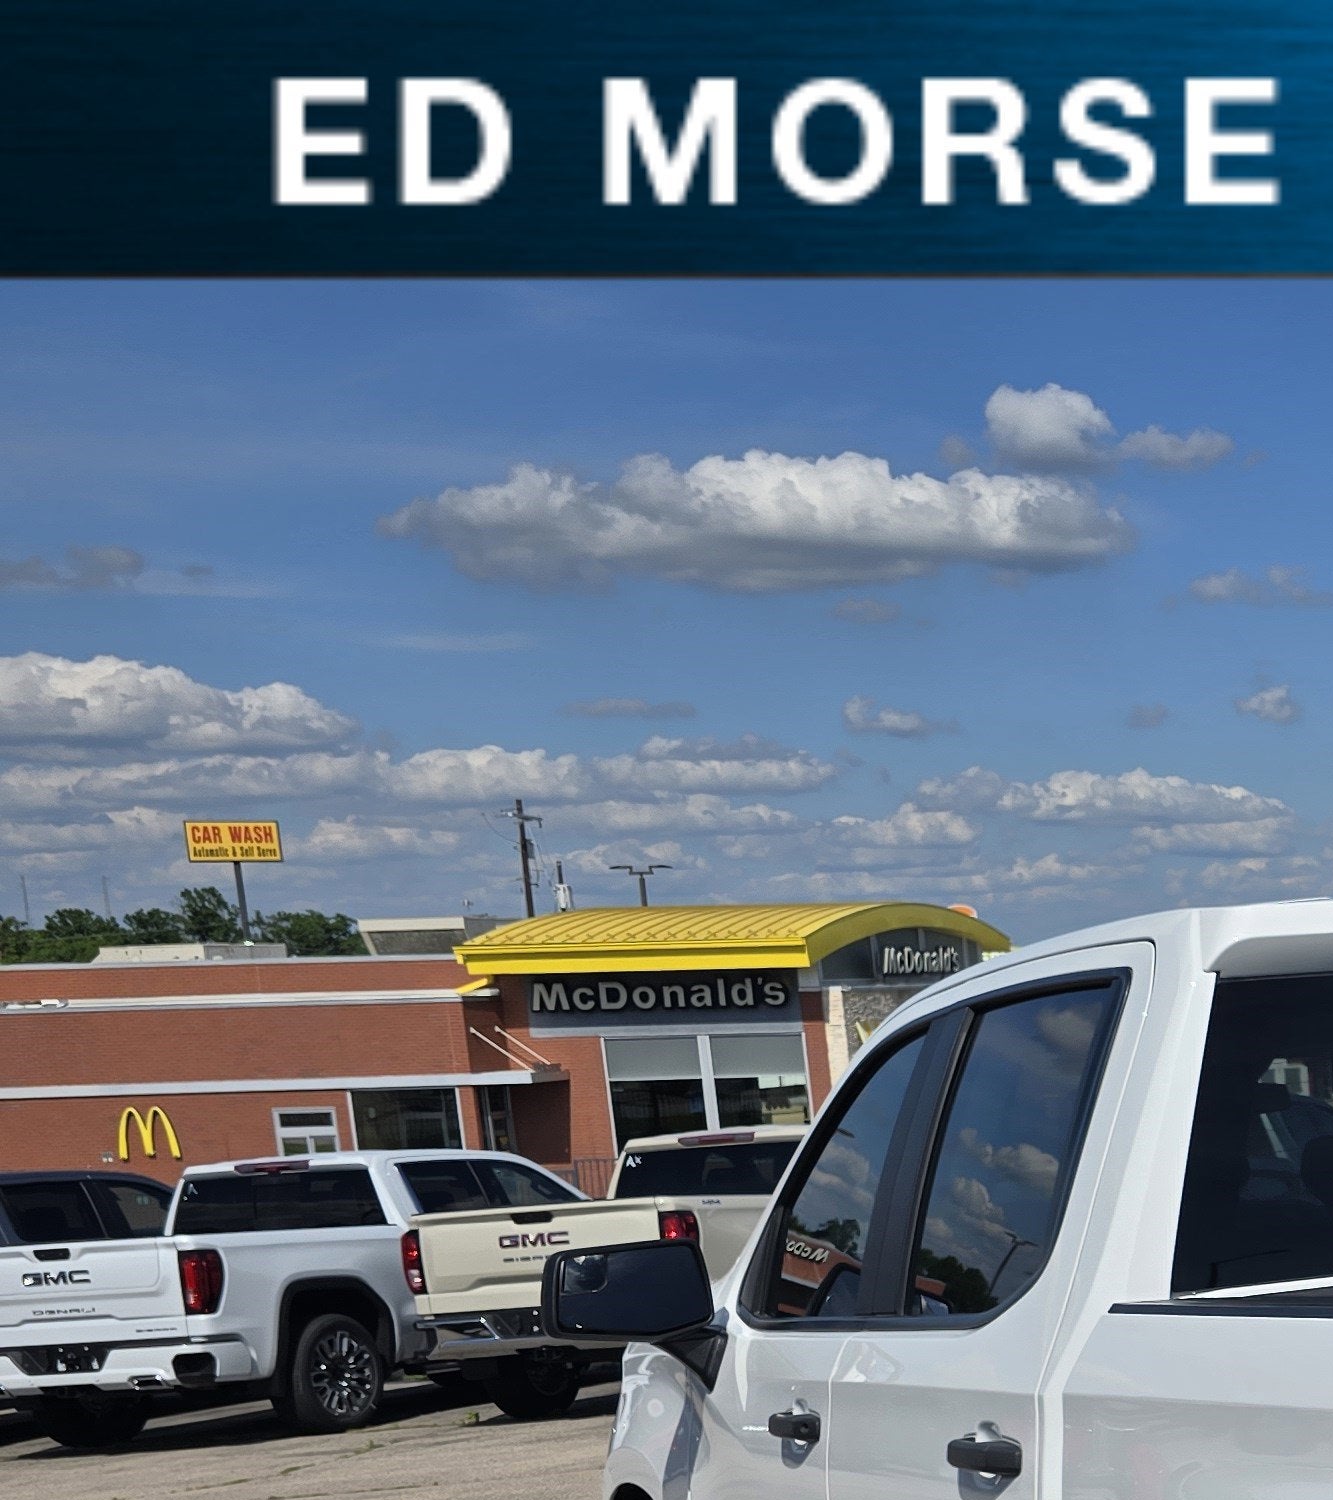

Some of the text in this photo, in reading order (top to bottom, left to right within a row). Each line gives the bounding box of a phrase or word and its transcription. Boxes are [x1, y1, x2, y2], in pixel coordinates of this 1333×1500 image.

[191, 825, 274, 844] CAR WASH
[193, 846, 277, 857] Automatic & Self Serve
[884, 945, 960, 974] McDonald's
[532, 976, 786, 1012] McDonald's
[499, 1231, 570, 1249] GMC
[22, 1270, 91, 1287] GMC
